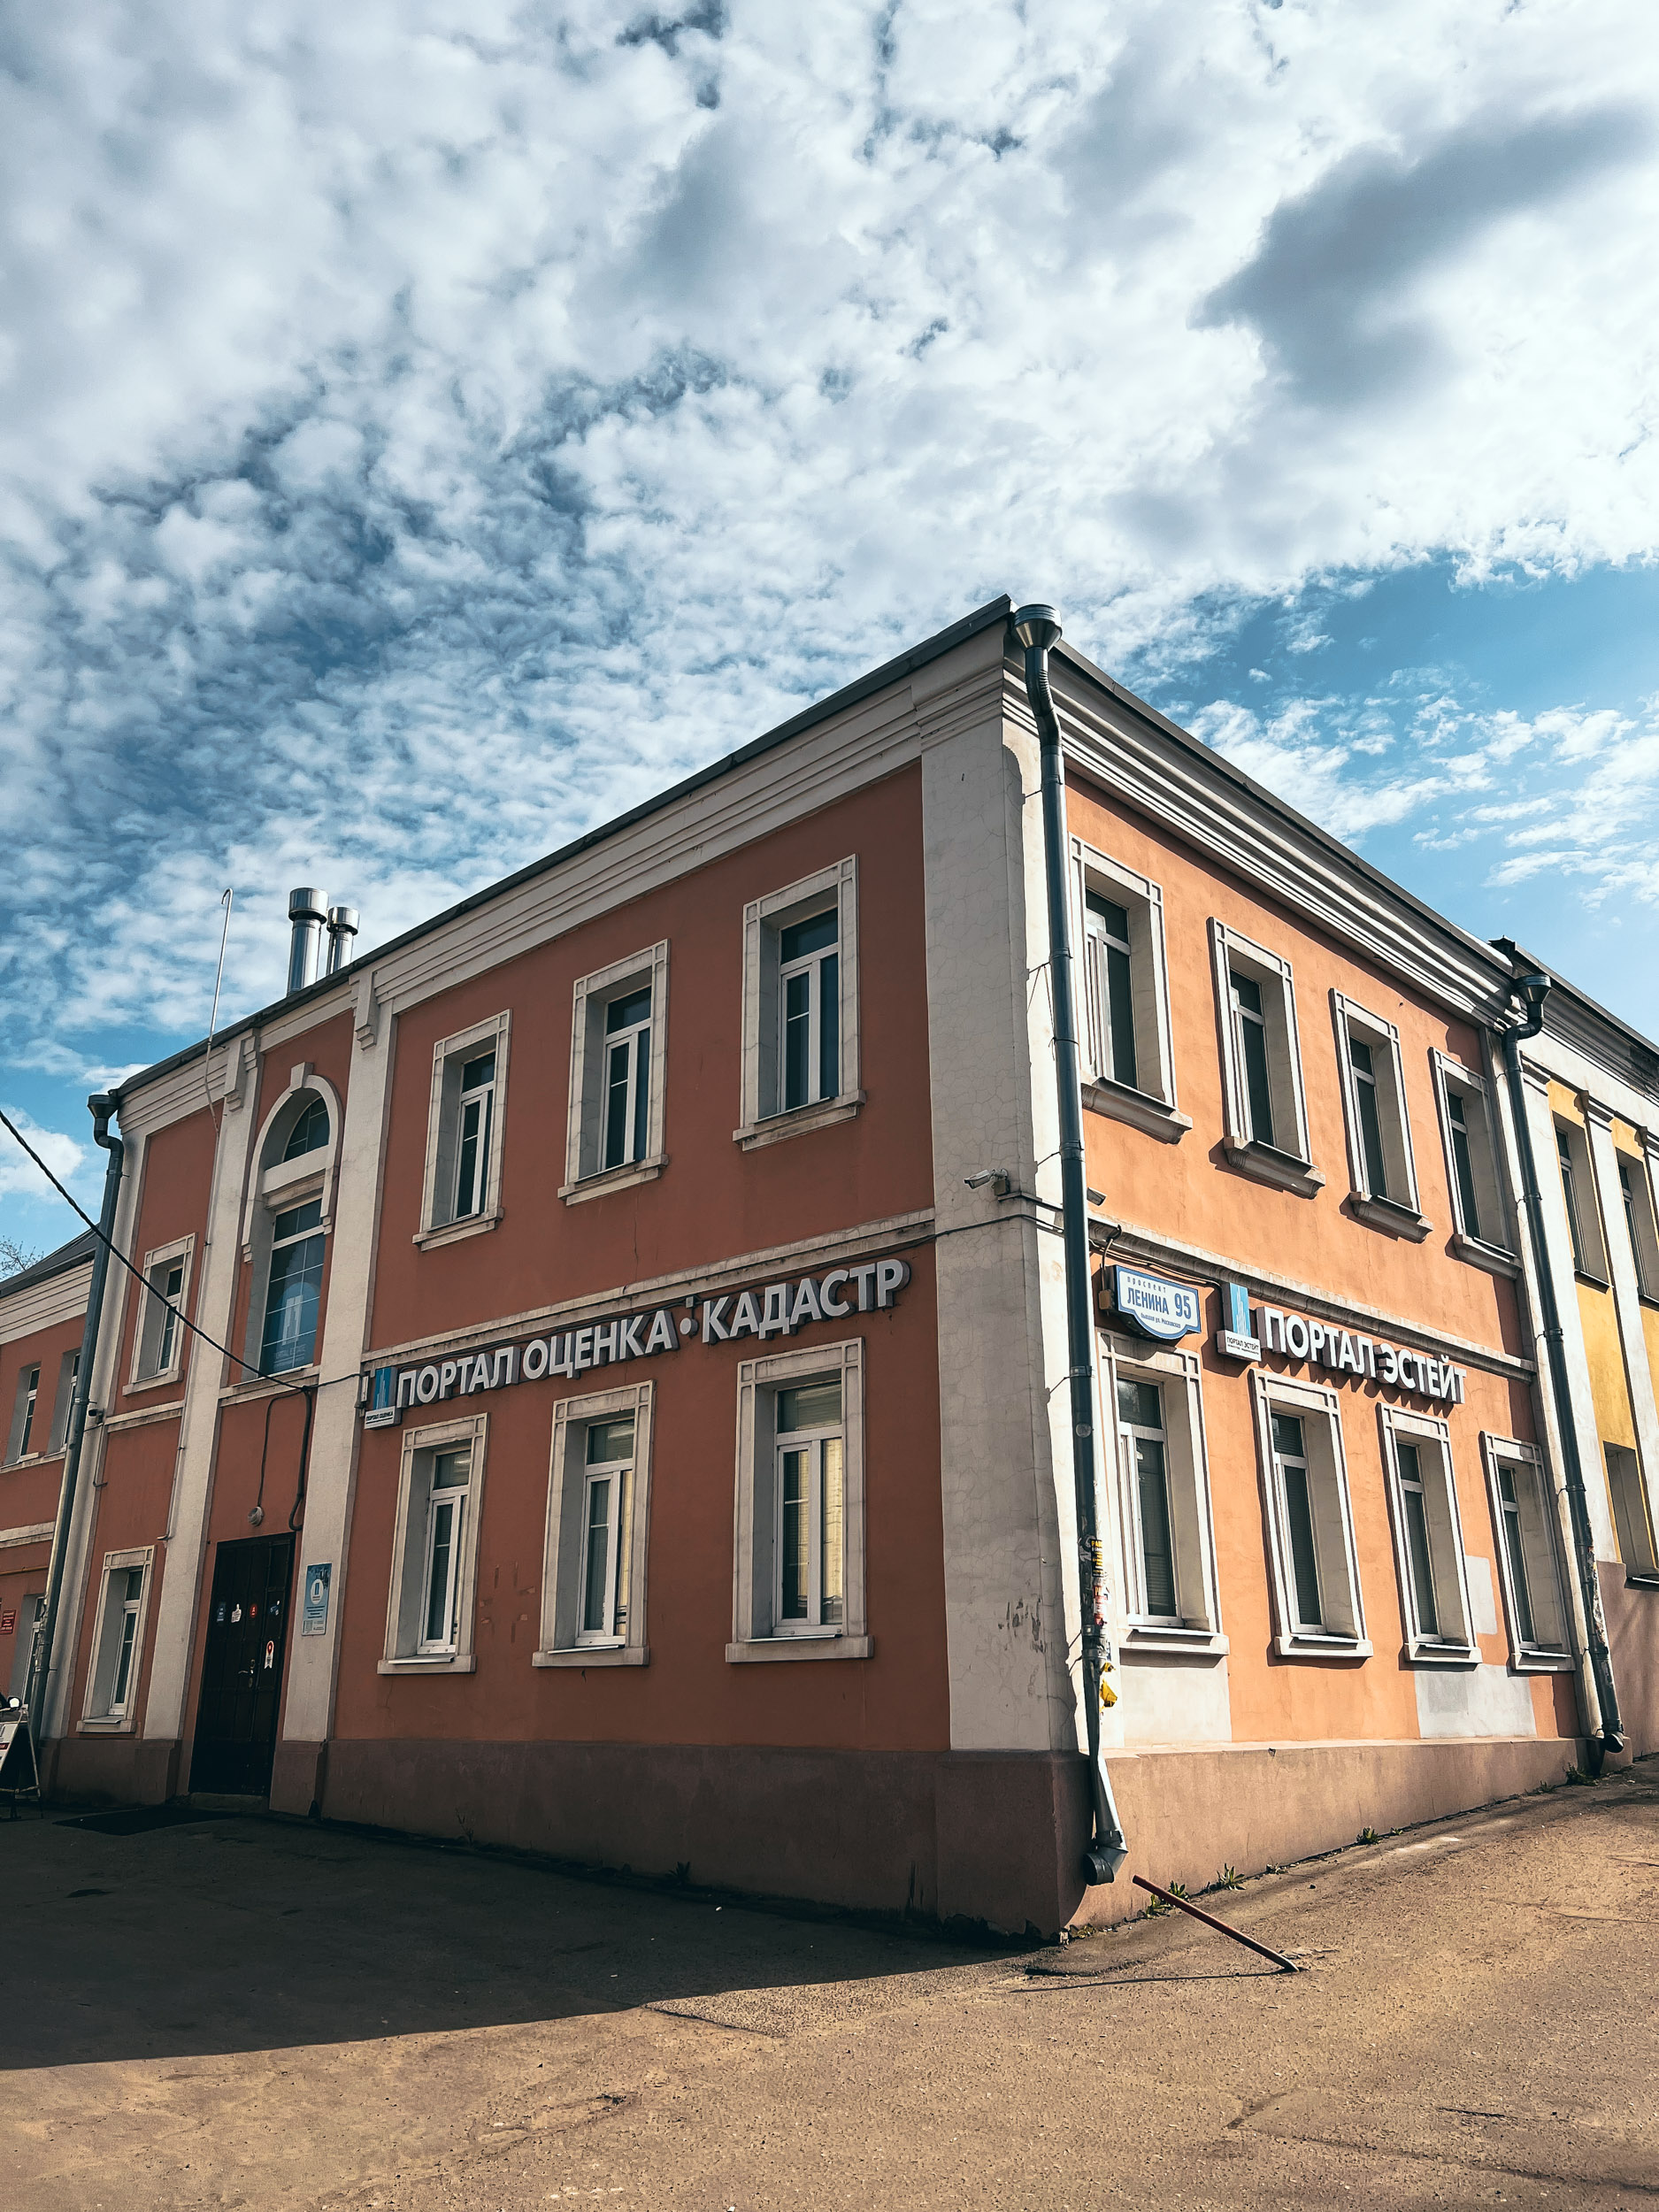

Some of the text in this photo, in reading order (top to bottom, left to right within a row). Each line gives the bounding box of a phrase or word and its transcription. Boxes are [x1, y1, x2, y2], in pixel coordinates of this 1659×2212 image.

[1126, 1276, 1166, 1293] проспект
[1126, 1287, 1192, 1320] ЛЕНИНА 95
[396, 1258, 905, 1409] ПОРТАЛ ОЦЕНКА КАДАСТР
[1226, 1336, 1244, 1348] ПОРТАЛ
[1243, 1341, 1260, 1352] ЭСТЕЙТ
[1263, 1305, 1467, 1404] ПОРТАЛ ЭСТЕЙТ
